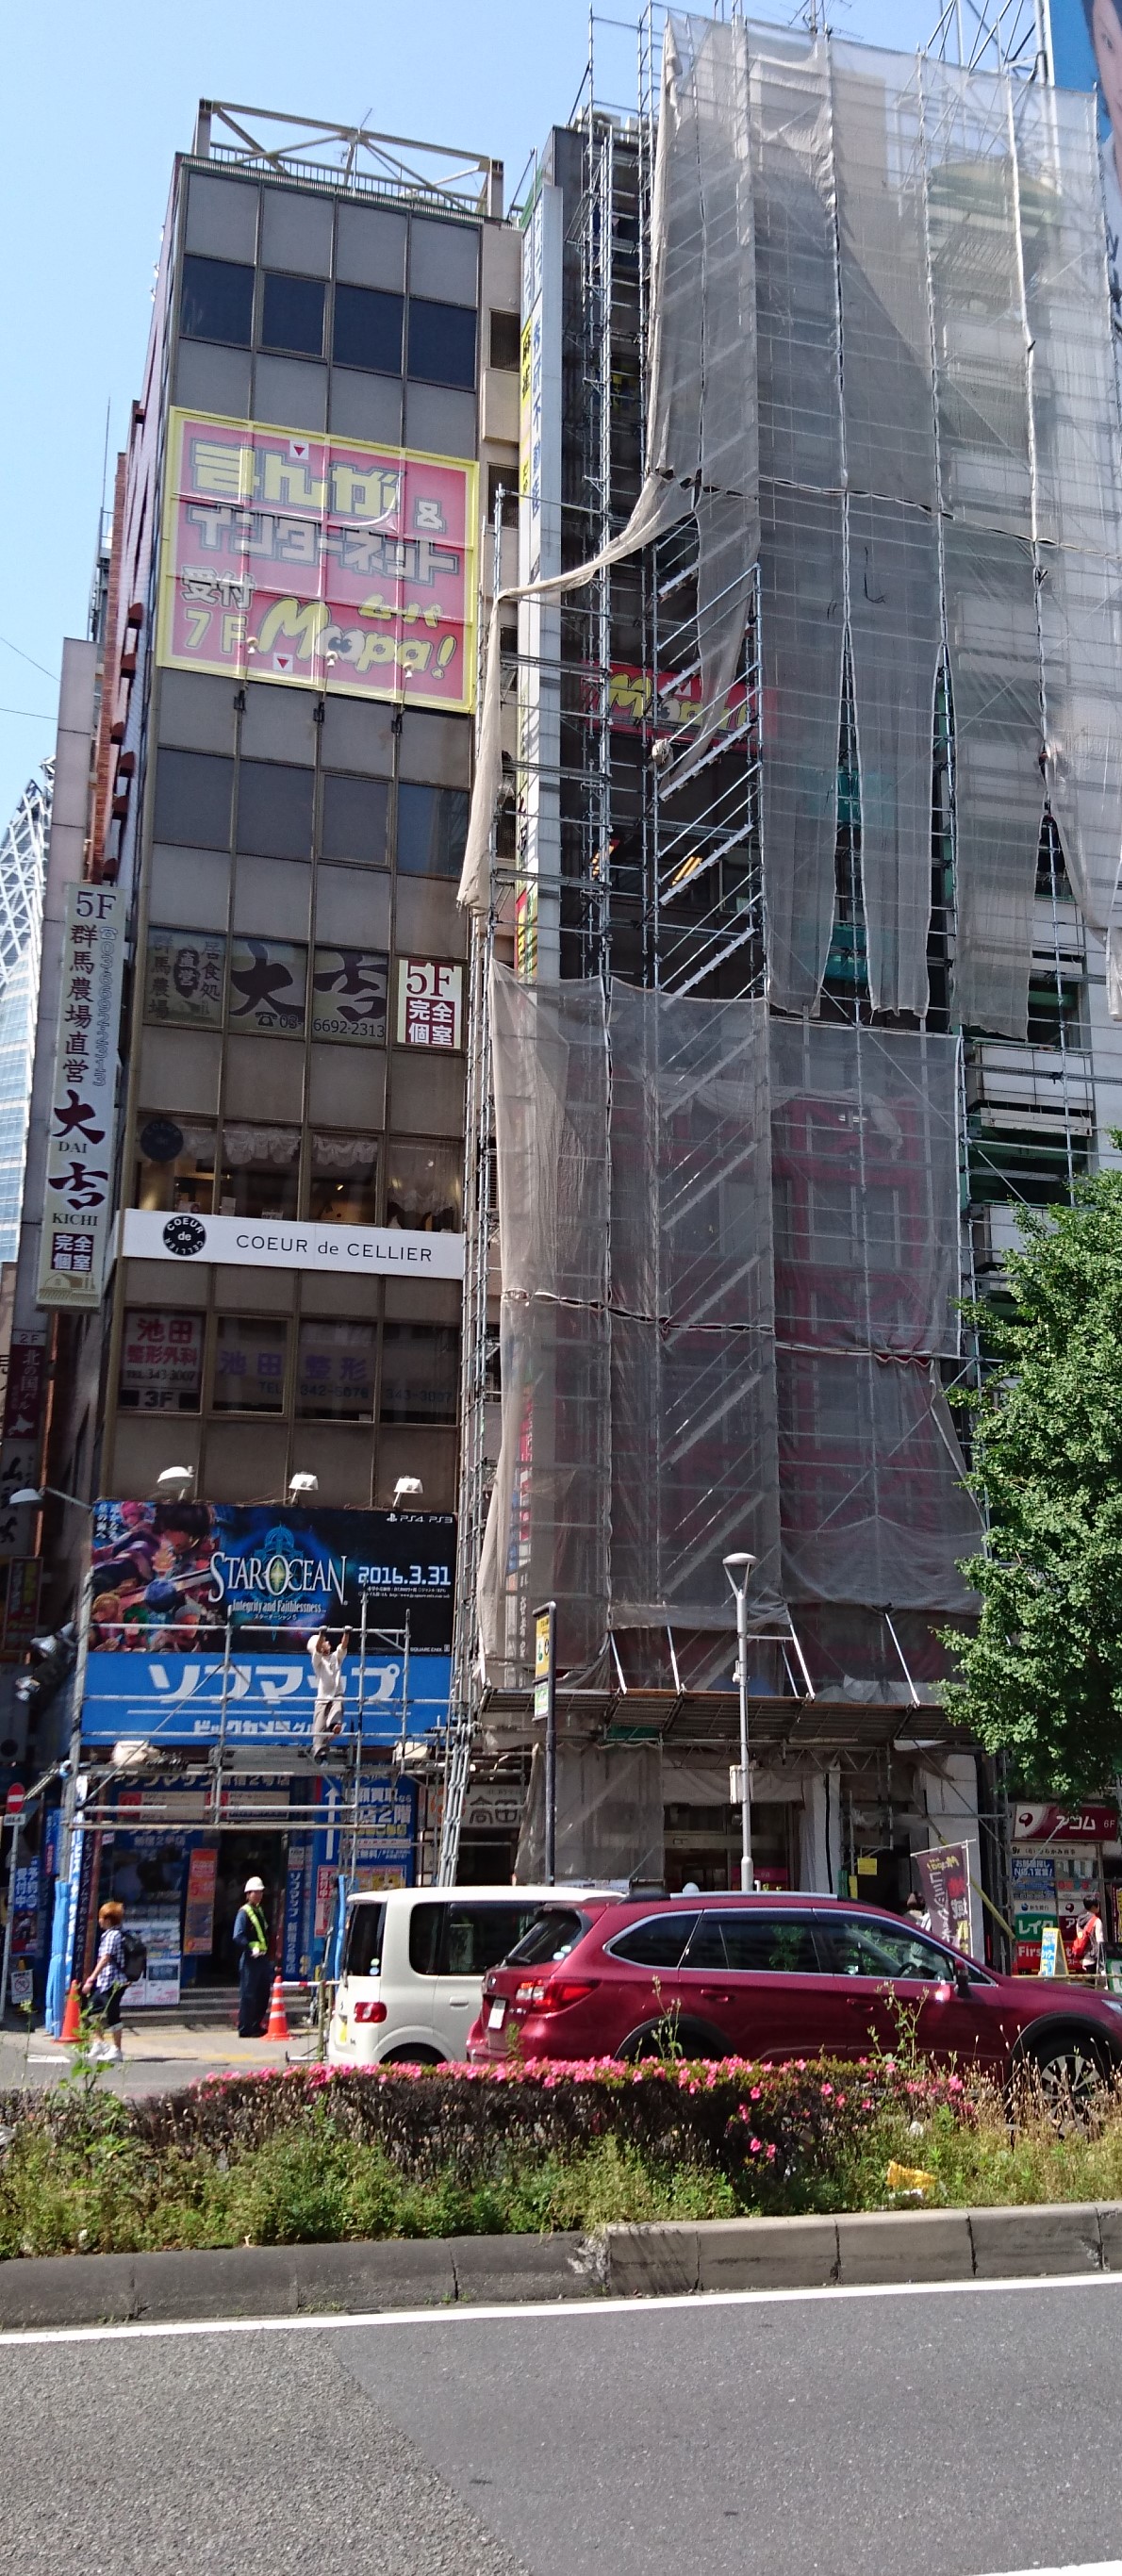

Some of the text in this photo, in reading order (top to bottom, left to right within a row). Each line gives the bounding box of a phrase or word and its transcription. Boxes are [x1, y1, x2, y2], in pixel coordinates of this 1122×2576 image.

[191, 439, 404, 519] まんが
[415, 498, 446, 533] &
[189, 501, 461, 586] インターネット
[182, 566, 256, 610] 受付
[184, 608, 247, 654] 7F
[76, 891, 117, 920] 5F
[148, 933, 173, 1019] 群馬農場
[201, 941, 222, 1002] 居食処
[405, 962, 454, 998] 5F
[62, 924, 99, 1084] 群馬農場直営
[407, 1001, 454, 1024] 完全
[407, 1025, 454, 1047] 個室
[58, 1142, 88, 1154] DAI
[52, 1212, 99, 1227] KICHI
[166, 1216, 205, 1235] COEUR
[54, 1233, 92, 1252] 完全
[177, 1230, 192, 1242] de
[236, 1233, 433, 1263] COEUR de CELLIER
[53, 1252, 92, 1271] 個室
[20, 1333, 39, 1344] 2F
[137, 1318, 192, 1345] 池田
[126, 1345, 198, 1365] 整形外科
[144, 1390, 175, 1408] 3F
[400, 1514, 454, 1524] PS4 PS3
[357, 1565, 452, 1586] 2016.3.31
[232, 1599, 261, 1613] Integrity
[262, 1600, 276, 1611] and
[1056, 1815, 1115, 1831] アコム 6F
